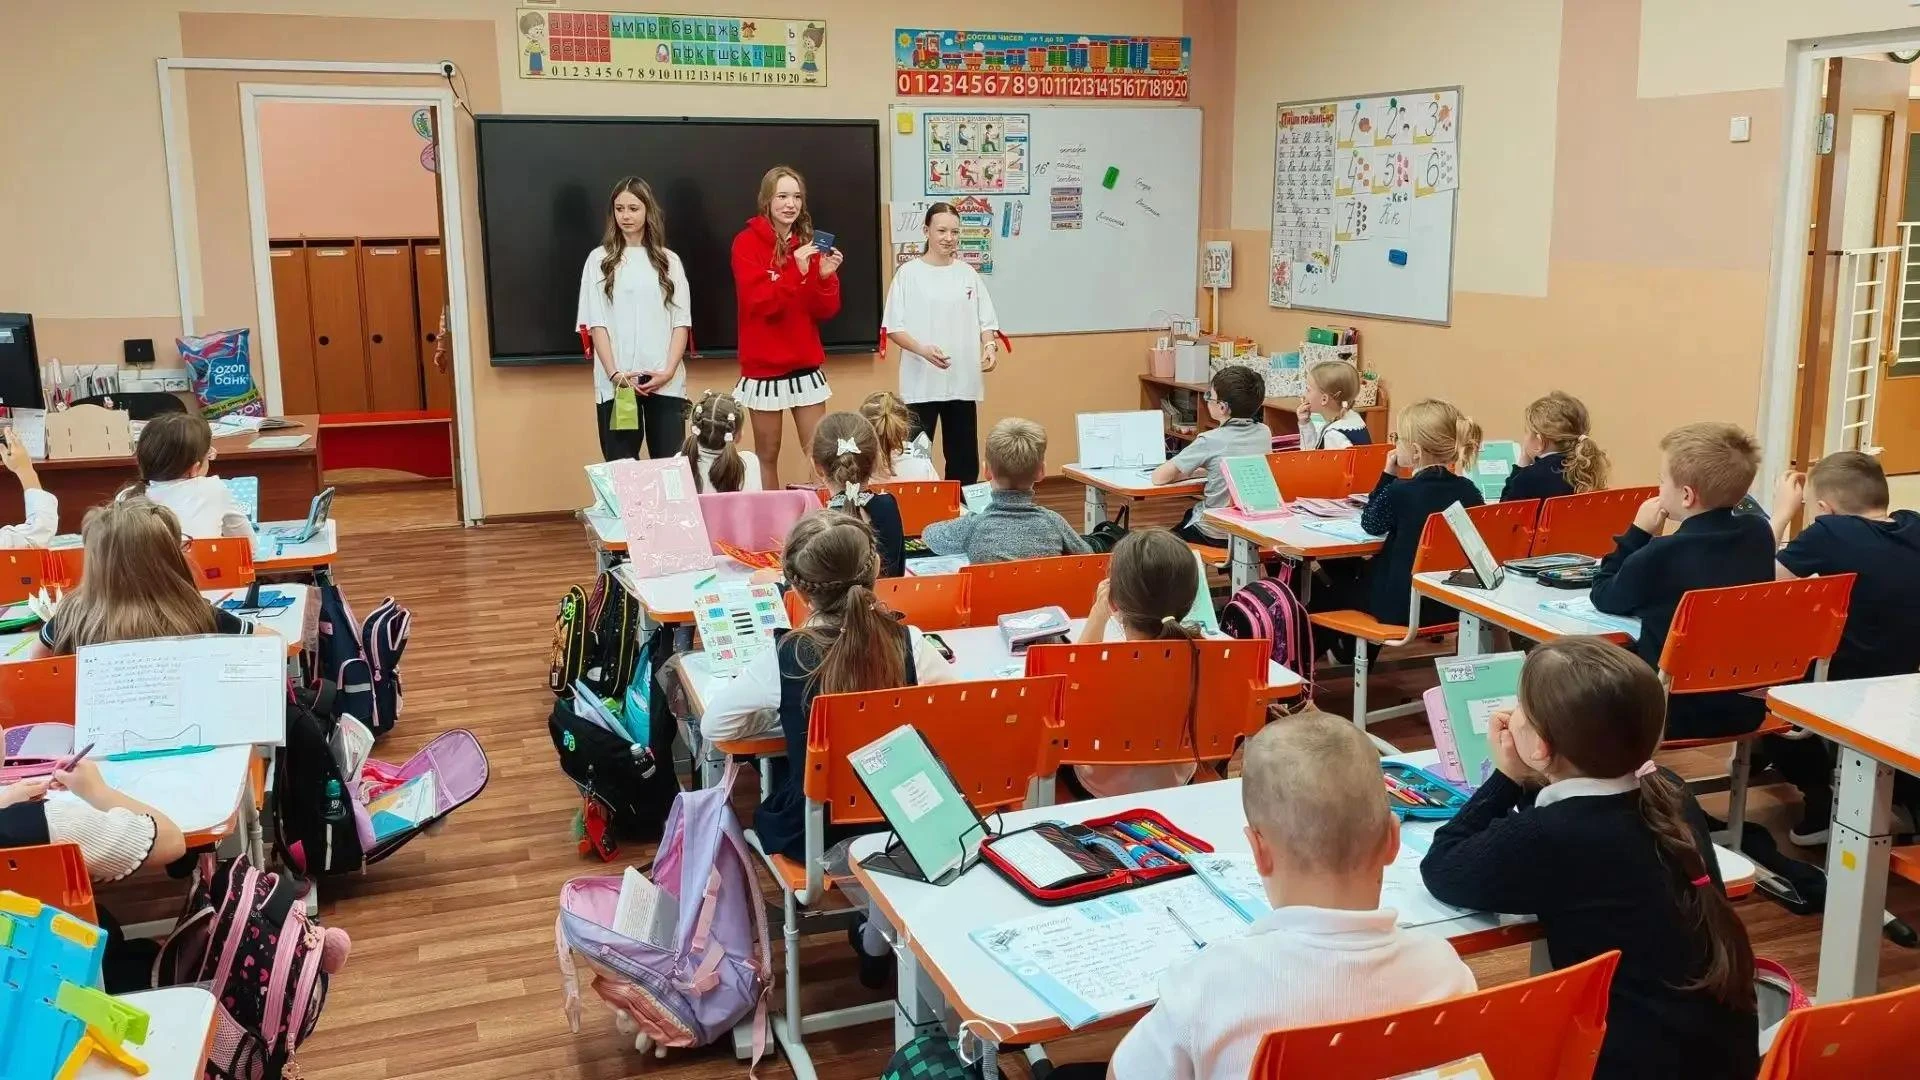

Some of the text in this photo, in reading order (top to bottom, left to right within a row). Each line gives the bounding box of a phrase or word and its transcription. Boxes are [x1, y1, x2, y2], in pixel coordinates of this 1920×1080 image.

[623, 22, 635, 32] м
[672, 20, 681, 34] б
[683, 24, 692, 34] в
[719, 25, 729, 36] ж
[684, 45, 694, 62] ф
[696, 48, 704, 59] к
[552, 67, 799, 83] 0 1 2 3 4 5 6 7 8 9 10 11 12 13 14 15 16 17 18 19 20
[899, 75, 1187, 96] 0 1 2 3 4 5 6 7 8 9 10 11 12 13 14 15 16 17 18 19 20
[1386, 106, 1397, 139] 2
[1425, 101, 1439, 137] 3
[1033, 163, 1048, 175] 16
[1347, 151, 1440, 190] 4 5 6
[1345, 202, 1355, 233] 7
[216, 364, 245, 376] ozon
[215, 372, 247, 385] банк
